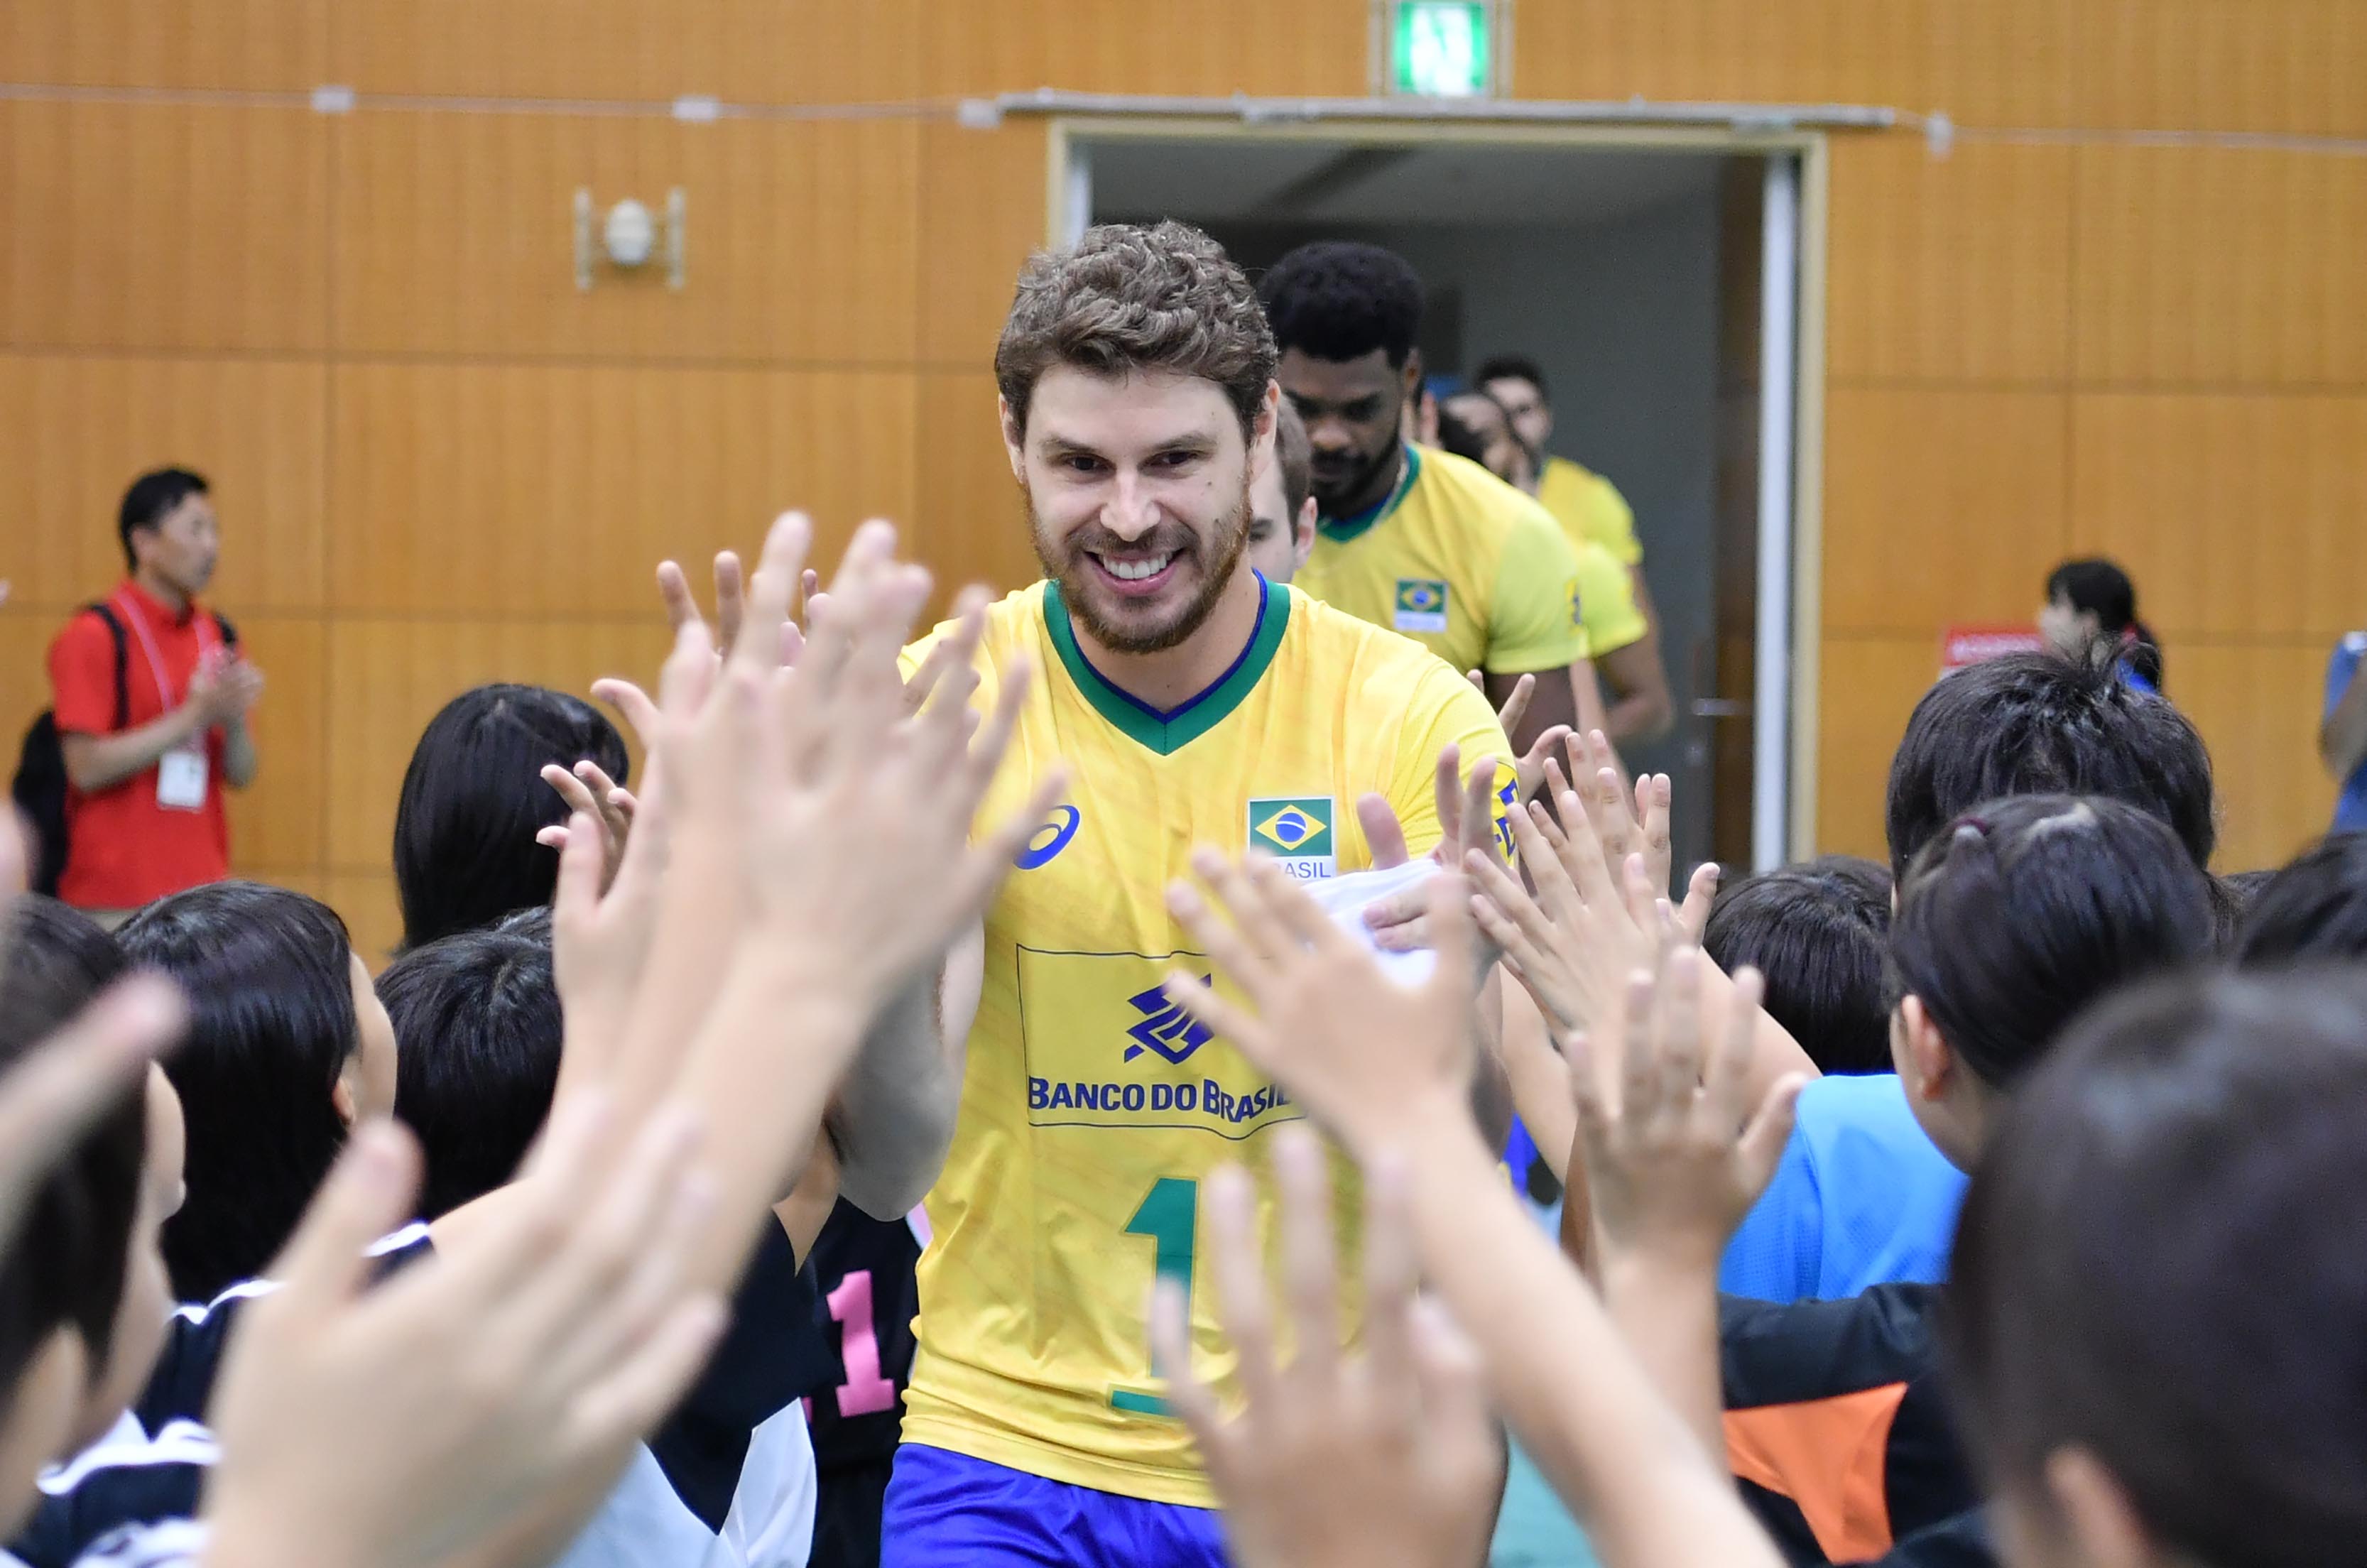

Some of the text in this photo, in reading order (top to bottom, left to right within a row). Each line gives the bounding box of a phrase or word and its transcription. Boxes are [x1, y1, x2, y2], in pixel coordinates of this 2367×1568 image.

[1276, 861, 1332, 878] ASIL
[1028, 1076, 1145, 1111] BANCO
[1151, 1084, 1197, 1111] DO
[1124, 1177, 1197, 1378] 1
[802, 1269, 895, 1418] 1
